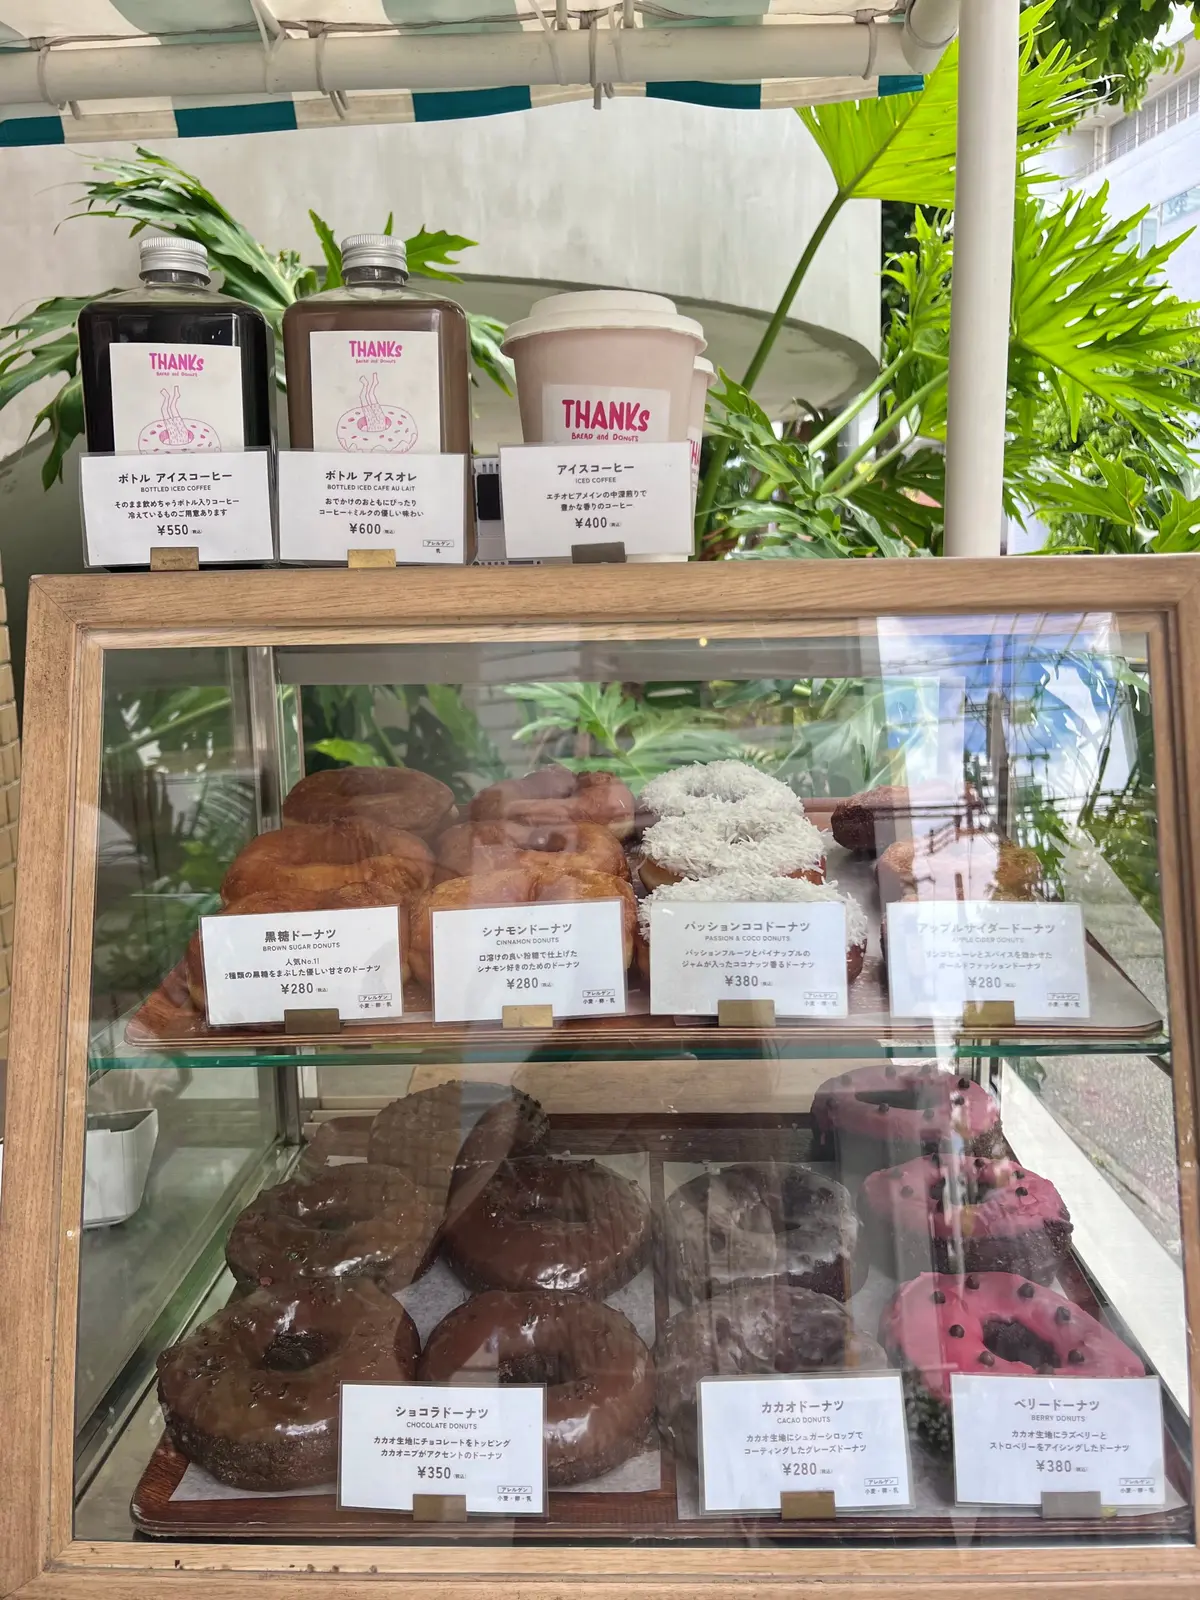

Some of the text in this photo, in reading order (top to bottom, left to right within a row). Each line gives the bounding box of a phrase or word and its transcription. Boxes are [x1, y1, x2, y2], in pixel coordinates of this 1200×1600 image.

[349, 340, 403, 358] THANKS
[149, 352, 204, 371] THANKS
[562, 400, 650, 431] THANKS
[596, 432, 609, 440] and
[557, 463, 634, 476] アイスコーヒー
[118, 472, 233, 484] ボトル アイスコーヒー
[325, 471, 417, 482] ボトル アイスオレ
[114, 498, 240, 509] そのまま飲めちゃうボトル入りコーヒー
[561, 502, 633, 512] 豊かな香りのコーヒー
[127, 509, 228, 519] 冷えているものご用意あります
[349, 523, 381, 534] ¥600
[575, 517, 607, 528] ¥400
[157, 524, 189, 536] ¥550
[482, 923, 572, 937] シナモンドーナツ
[684, 921, 811, 932] パッションココドーナツ
[918, 922, 1056, 935] アップルサイダードーナツ
[264, 929, 336, 943] 黒糖ドーナツ
[479, 950, 577, 962] 口溶けの良い粉糖で仕上げた
[225, 965, 380, 980] 2種類の黒糖をまぶした優しい甘さのドーナツ
[477, 961, 580, 973] シナモン好きのためのドーナツ
[506, 977, 538, 989] ¥280
[725, 975, 758, 986] ¥380
[968, 976, 1001, 988] ¥280
[281, 982, 314, 994] ¥280
[762, 1400, 844, 1414] カカオドーナツ
[1014, 1398, 1100, 1411] ベリードーナツ
[395, 1406, 488, 1419] ショコラドーナツ
[746, 1431, 863, 1443] カカオ生地にシュガーシロップで
[1012, 1430, 1107, 1440] カカオ生地にラズベリーと
[374, 1436, 510, 1447] カカオ生地にチョコレートをトッピング
[990, 1442, 1130, 1452] ストロベリーをアイシングしたドーナツ
[381, 1449, 502, 1460] カカオニブがアクセントのドーナツ
[744, 1444, 866, 1455] コーティングしたグレーズドーナツ
[782, 1462, 817, 1476] ¥280
[1036, 1460, 1072, 1472] ¥380
[418, 1466, 451, 1479] ¥350
